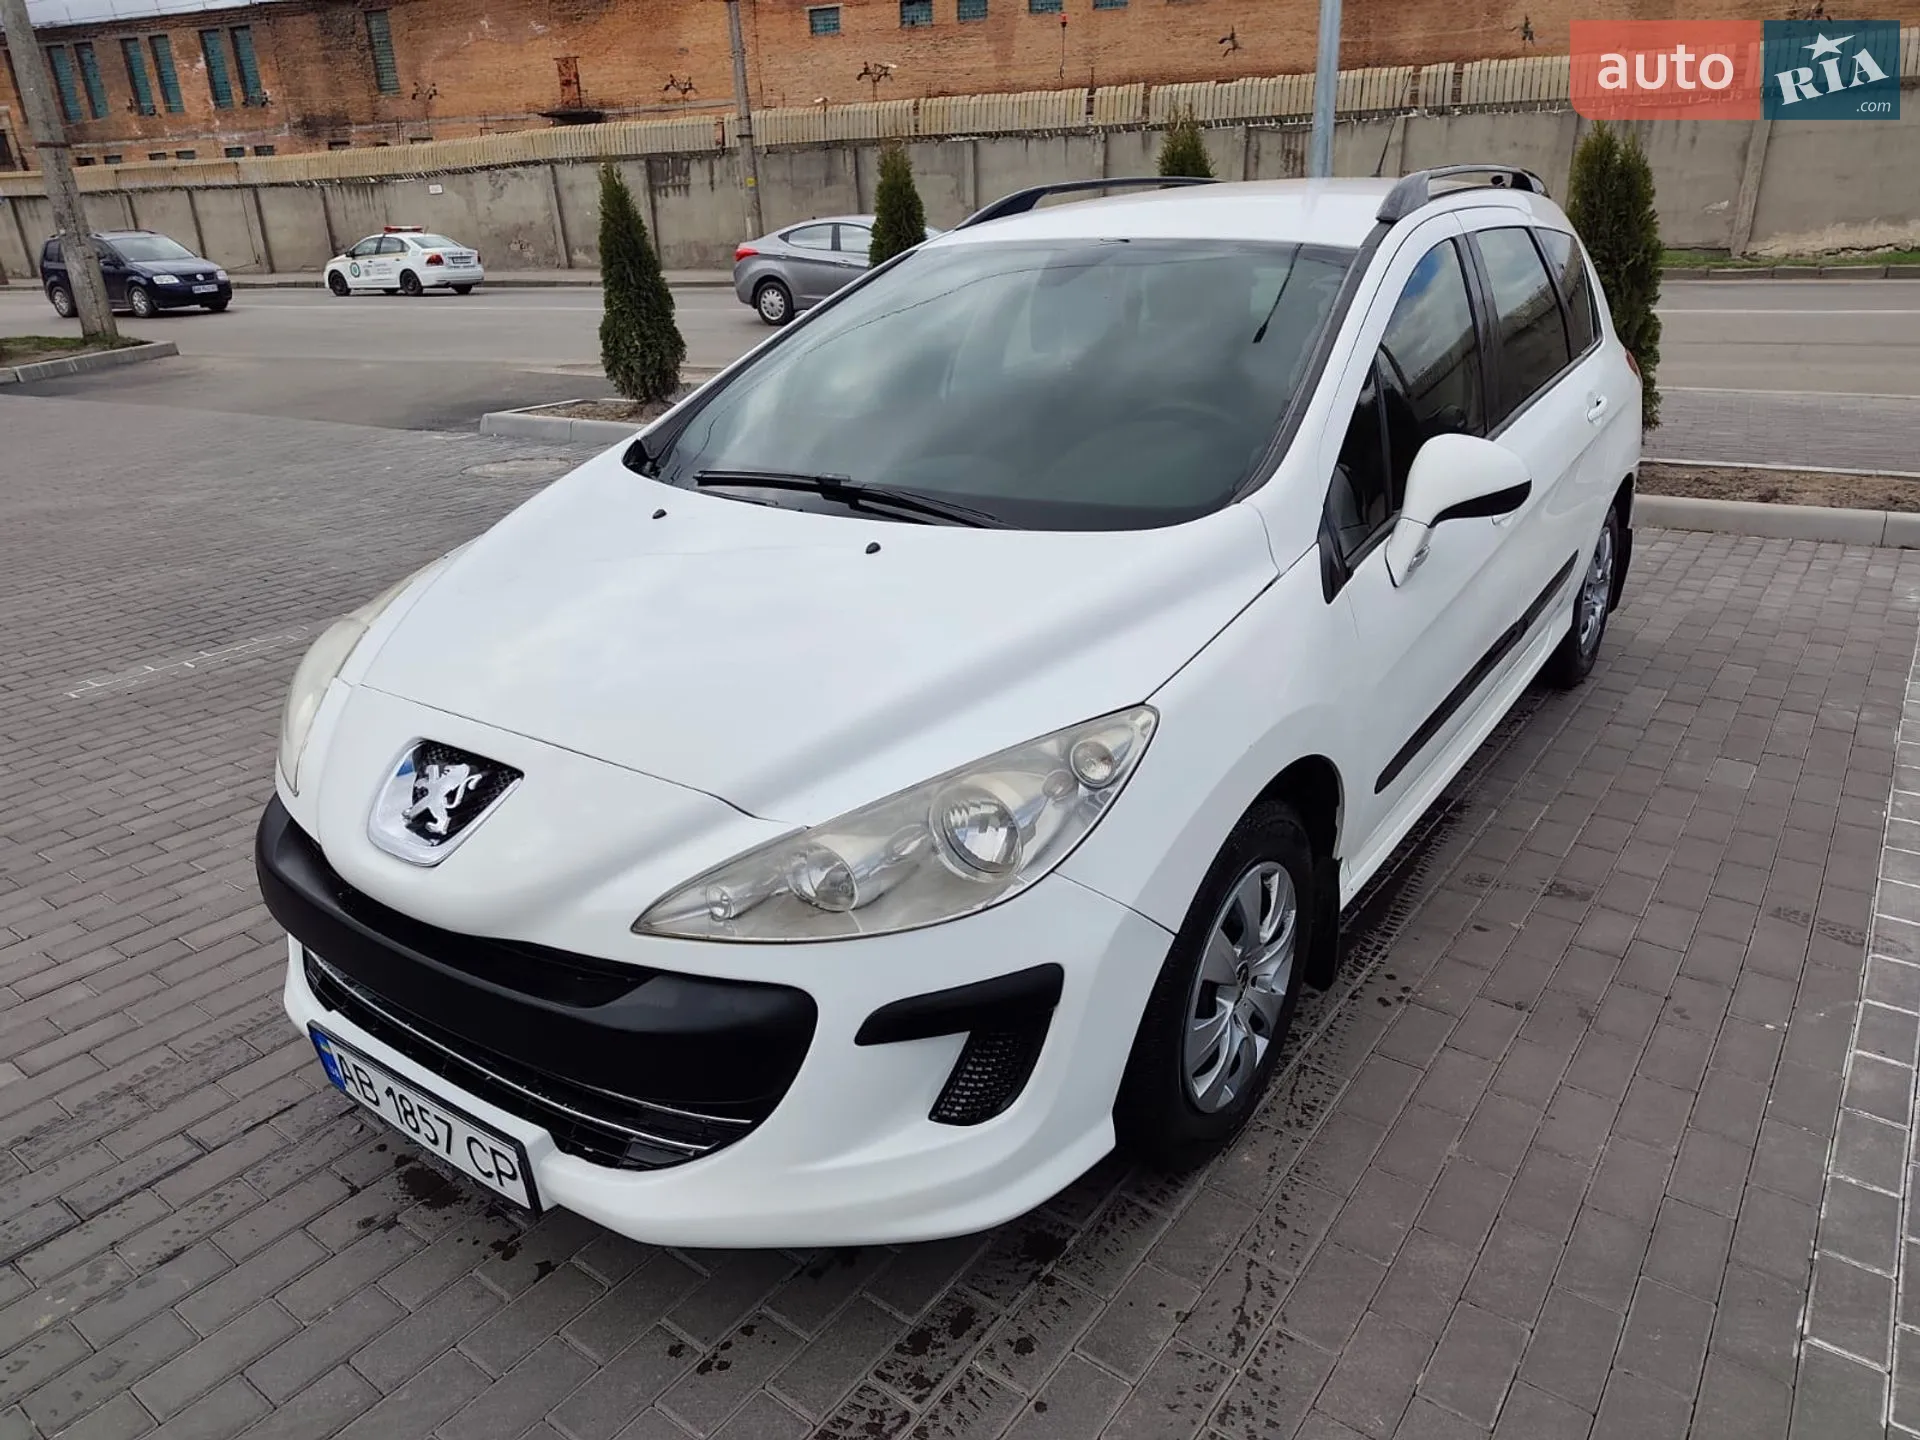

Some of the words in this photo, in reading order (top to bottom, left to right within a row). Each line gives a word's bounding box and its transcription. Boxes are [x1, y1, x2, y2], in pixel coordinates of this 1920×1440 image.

[337, 1053, 380, 1107] AB
[385, 1086, 453, 1154] 1857
[466, 1136, 518, 1187] CP
